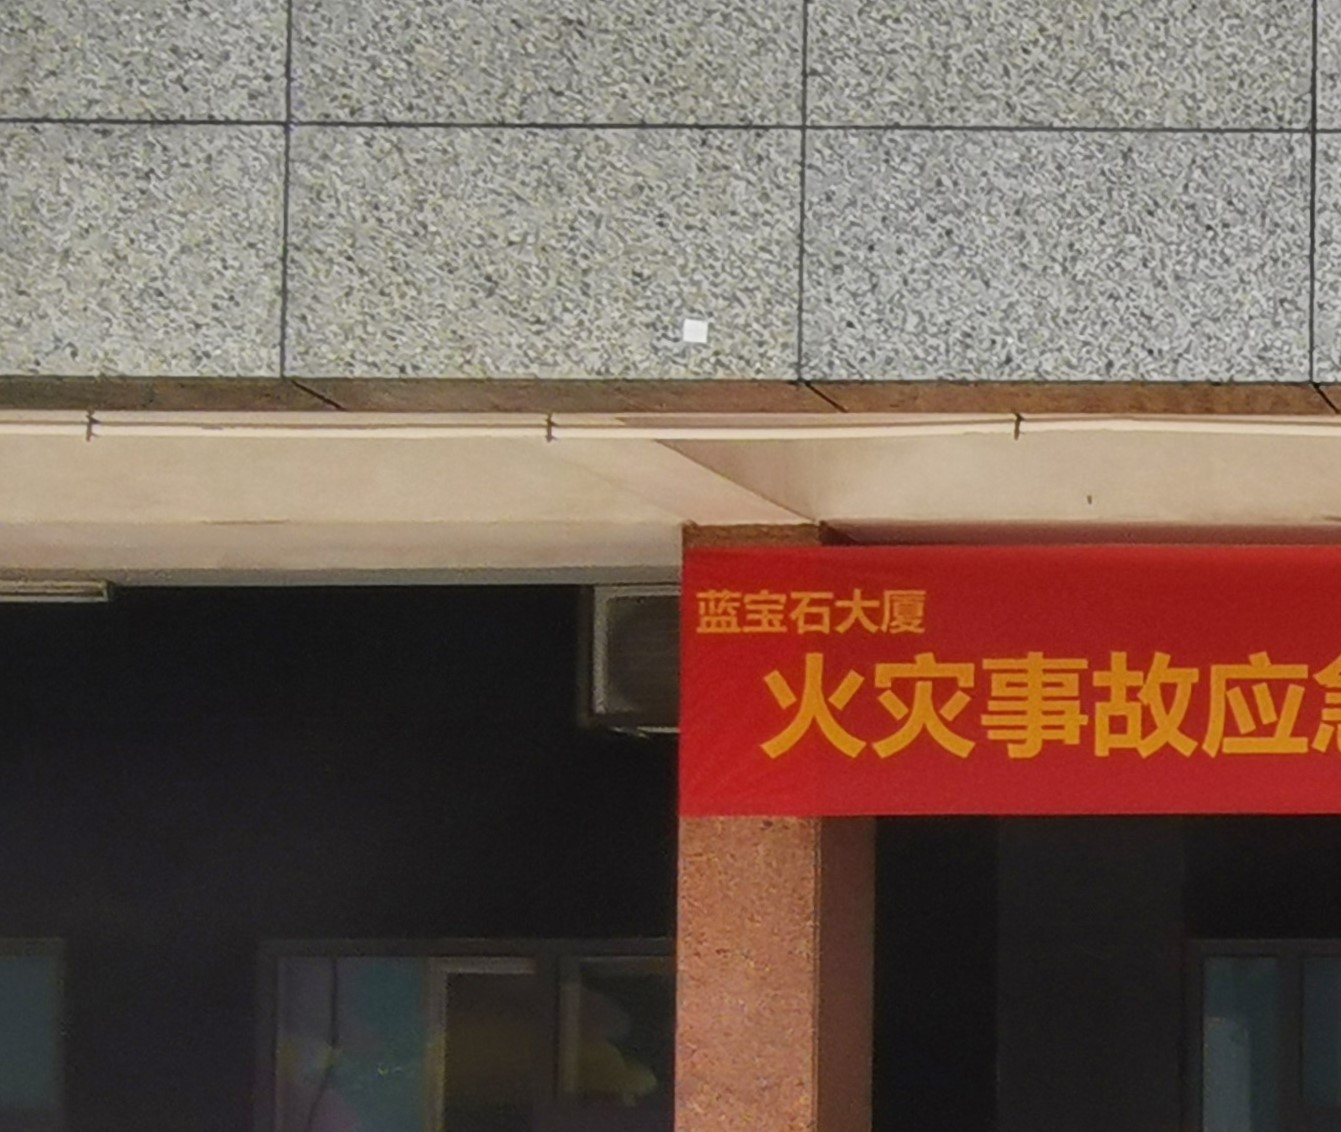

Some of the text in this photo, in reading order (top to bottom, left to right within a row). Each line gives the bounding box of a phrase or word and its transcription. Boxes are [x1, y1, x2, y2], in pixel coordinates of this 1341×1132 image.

[695, 588, 926, 635] 蓝宝石大厦
